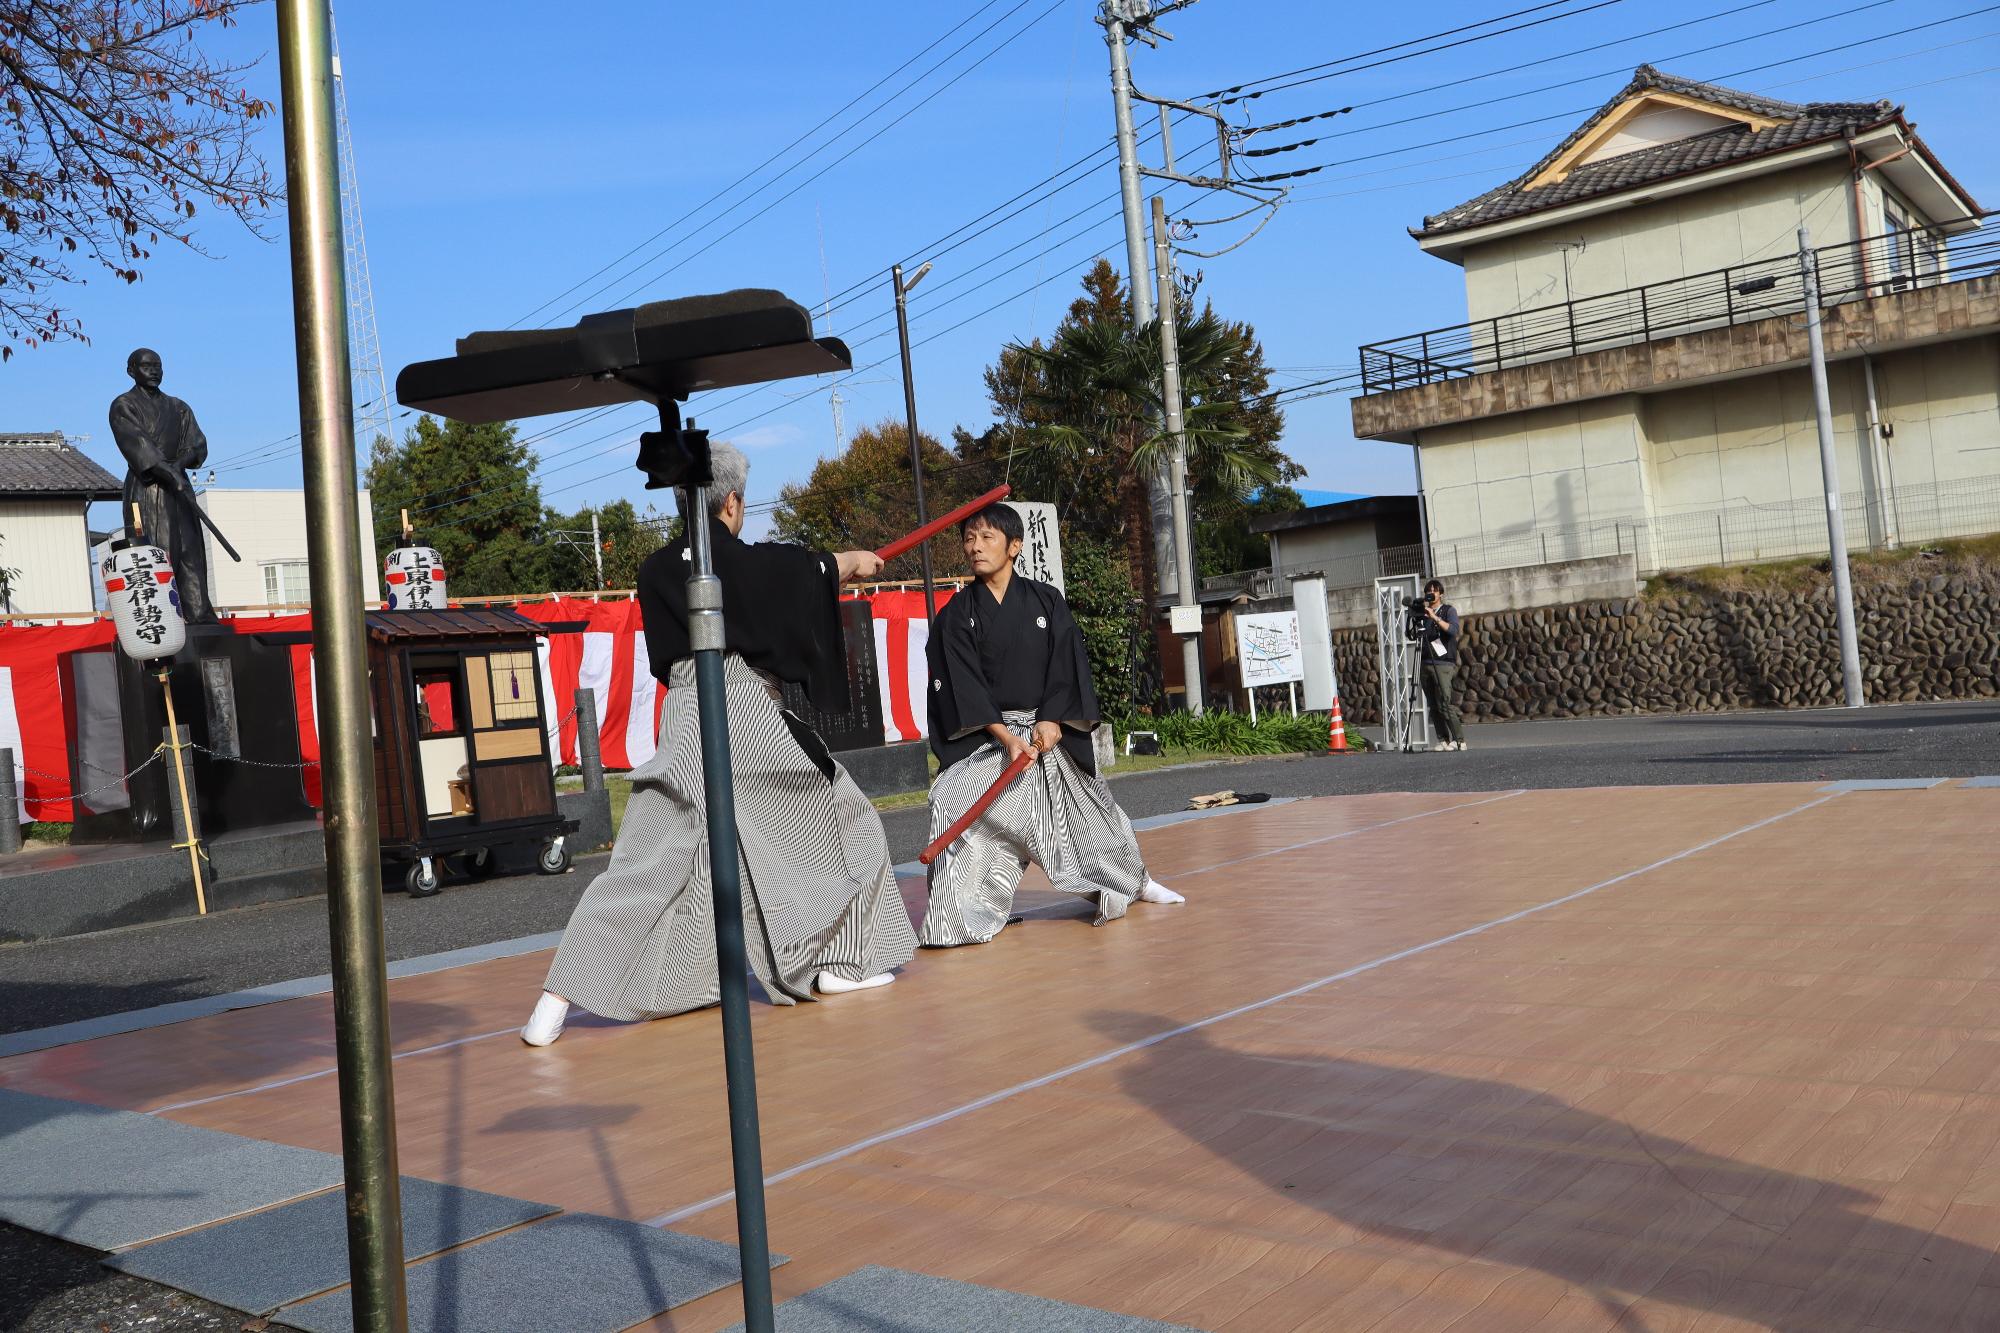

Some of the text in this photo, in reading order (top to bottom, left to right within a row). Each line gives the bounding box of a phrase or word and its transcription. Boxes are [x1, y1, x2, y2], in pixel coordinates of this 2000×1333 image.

[121, 552, 166, 644] 上泉伊勢守
